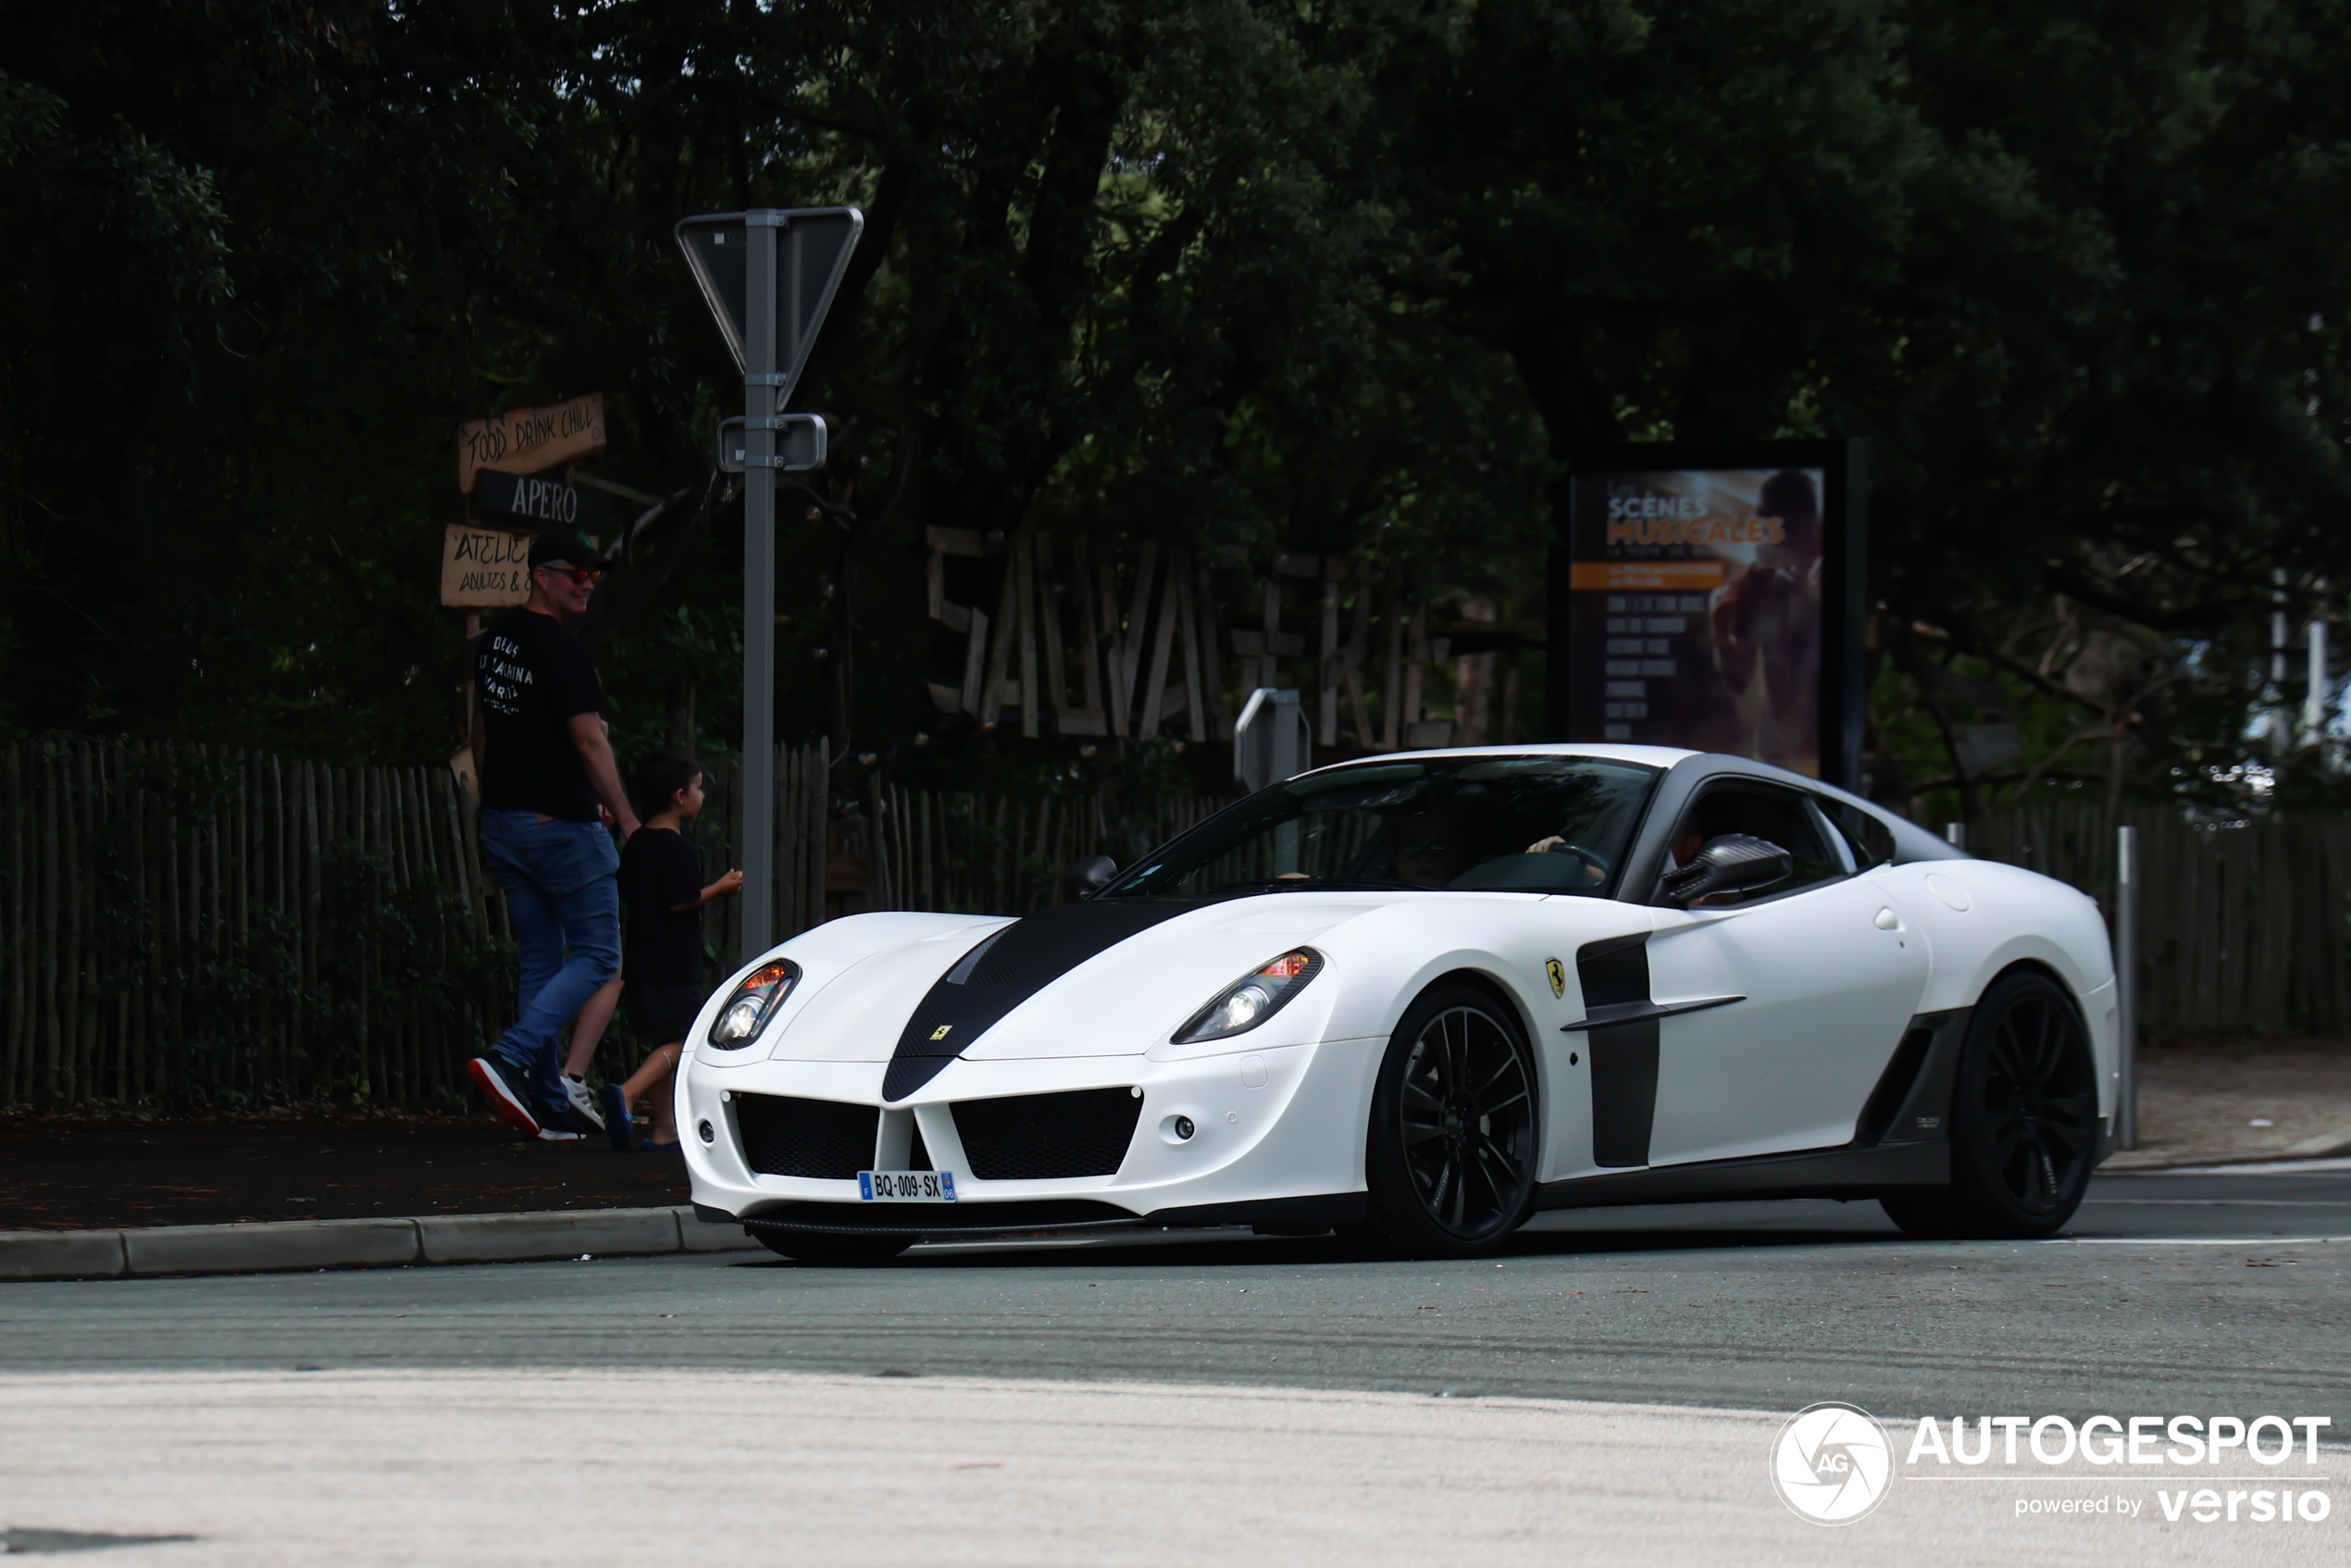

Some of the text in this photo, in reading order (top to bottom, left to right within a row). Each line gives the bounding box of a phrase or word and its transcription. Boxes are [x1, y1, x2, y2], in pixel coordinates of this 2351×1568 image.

[468, 404, 593, 469] FOOD DRINK CHILL
[511, 476, 578, 525] APERO
[1606, 515, 1785, 546] MUSICALES
[454, 532, 526, 565] ATELIE
[459, 570, 532, 592] ADULTES & E
[492, 635, 520, 660] DEUS
[864, 1188, 870, 1197] F
[875, 1175, 940, 1198] BQ-009-SX
[944, 1188, 955, 1200] 06
